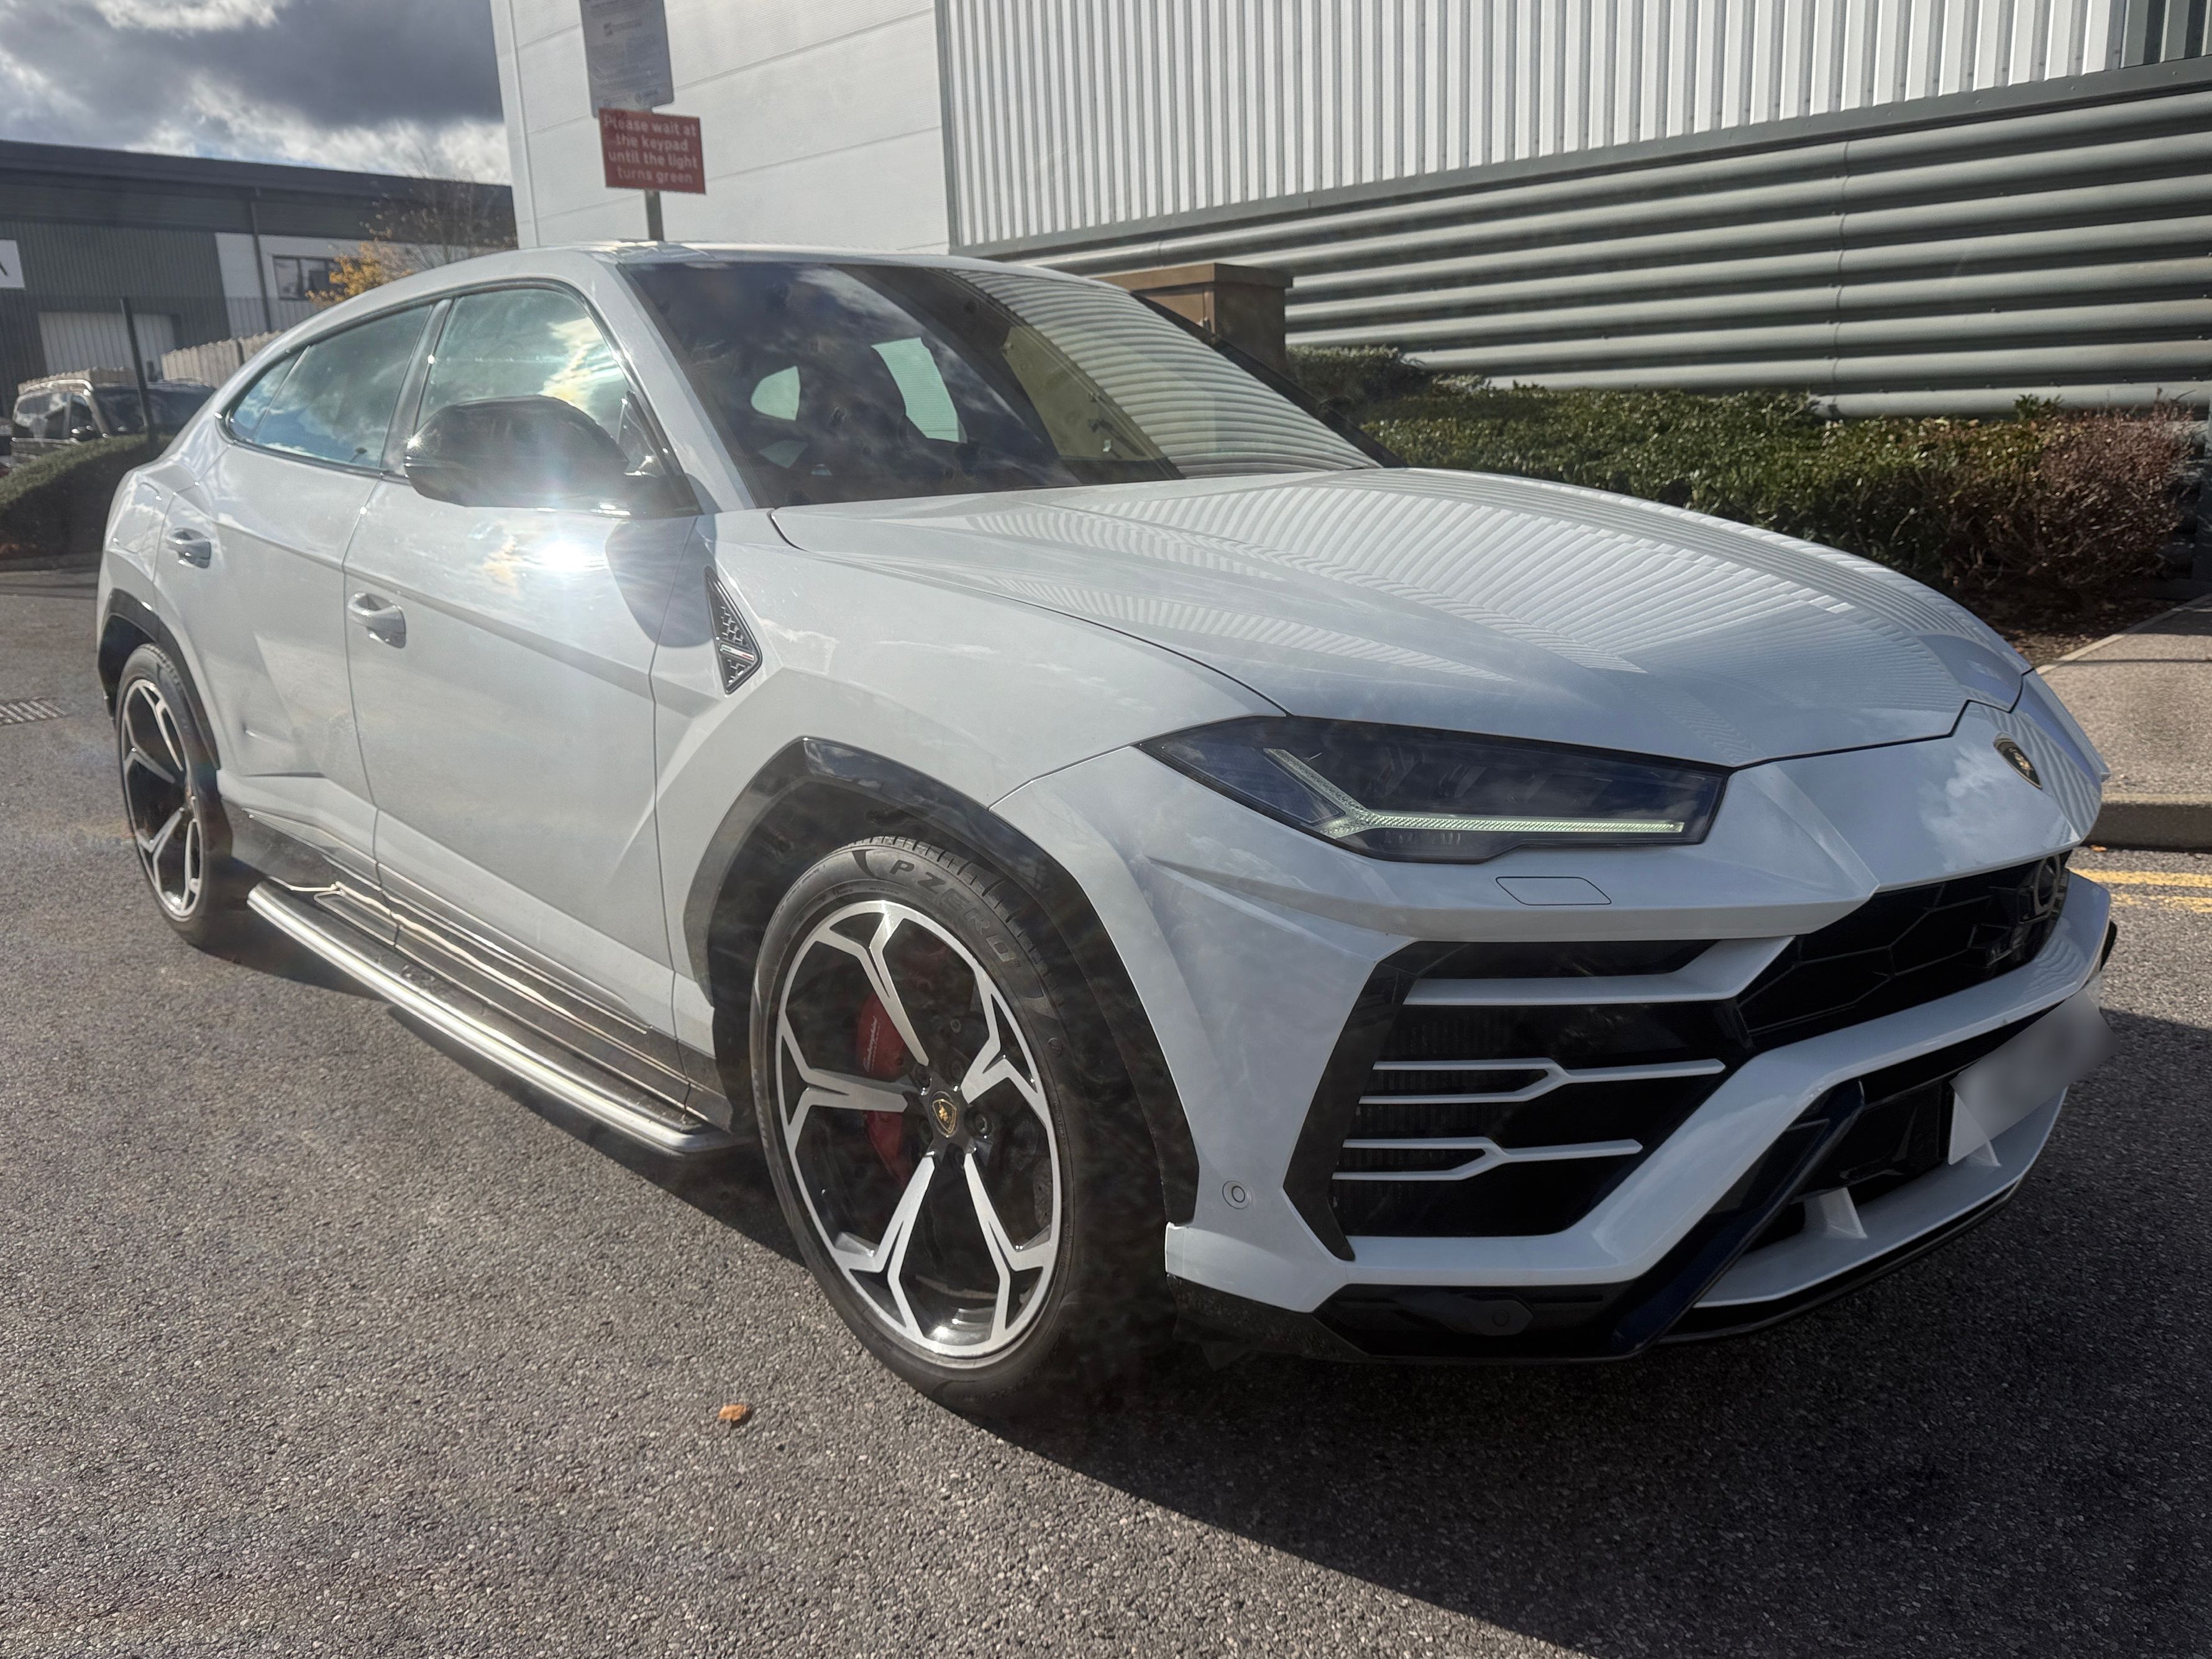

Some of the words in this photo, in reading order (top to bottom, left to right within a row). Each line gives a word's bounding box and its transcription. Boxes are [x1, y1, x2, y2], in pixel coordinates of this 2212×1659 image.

[603, 114, 648, 132] Please
[651, 121, 680, 136] wait
[683, 124, 697, 137] at
[616, 132, 638, 149] the
[641, 134, 688, 152] keypad
[608, 150, 640, 164] until
[643, 152, 665, 167] the
[668, 153, 697, 170] light
[617, 166, 652, 181] turns
[656, 171, 693, 185] green
[889, 859, 915, 875] P
[917, 872, 1017, 962] ZERO
